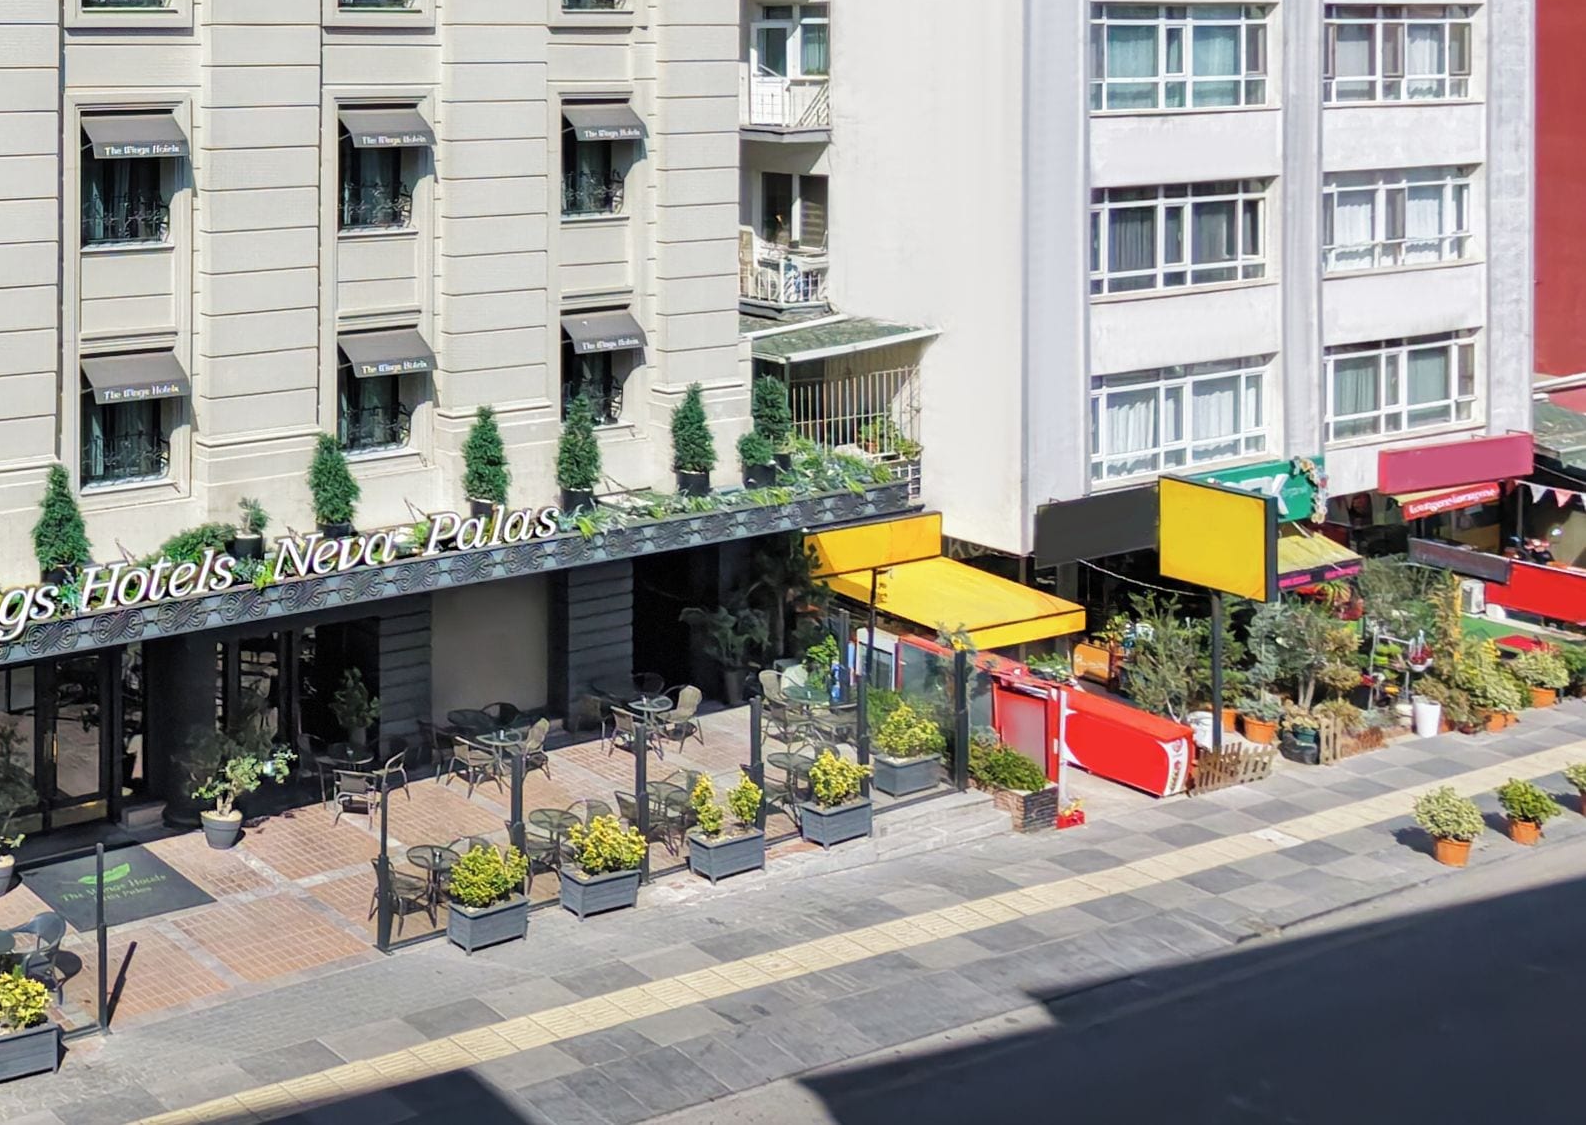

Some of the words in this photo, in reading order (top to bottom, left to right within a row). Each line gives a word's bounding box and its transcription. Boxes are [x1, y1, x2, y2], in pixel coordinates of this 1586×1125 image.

[79, 550, 237, 614] Hotels
[273, 531, 398, 581] Neva
[421, 504, 560, 557] Palas
